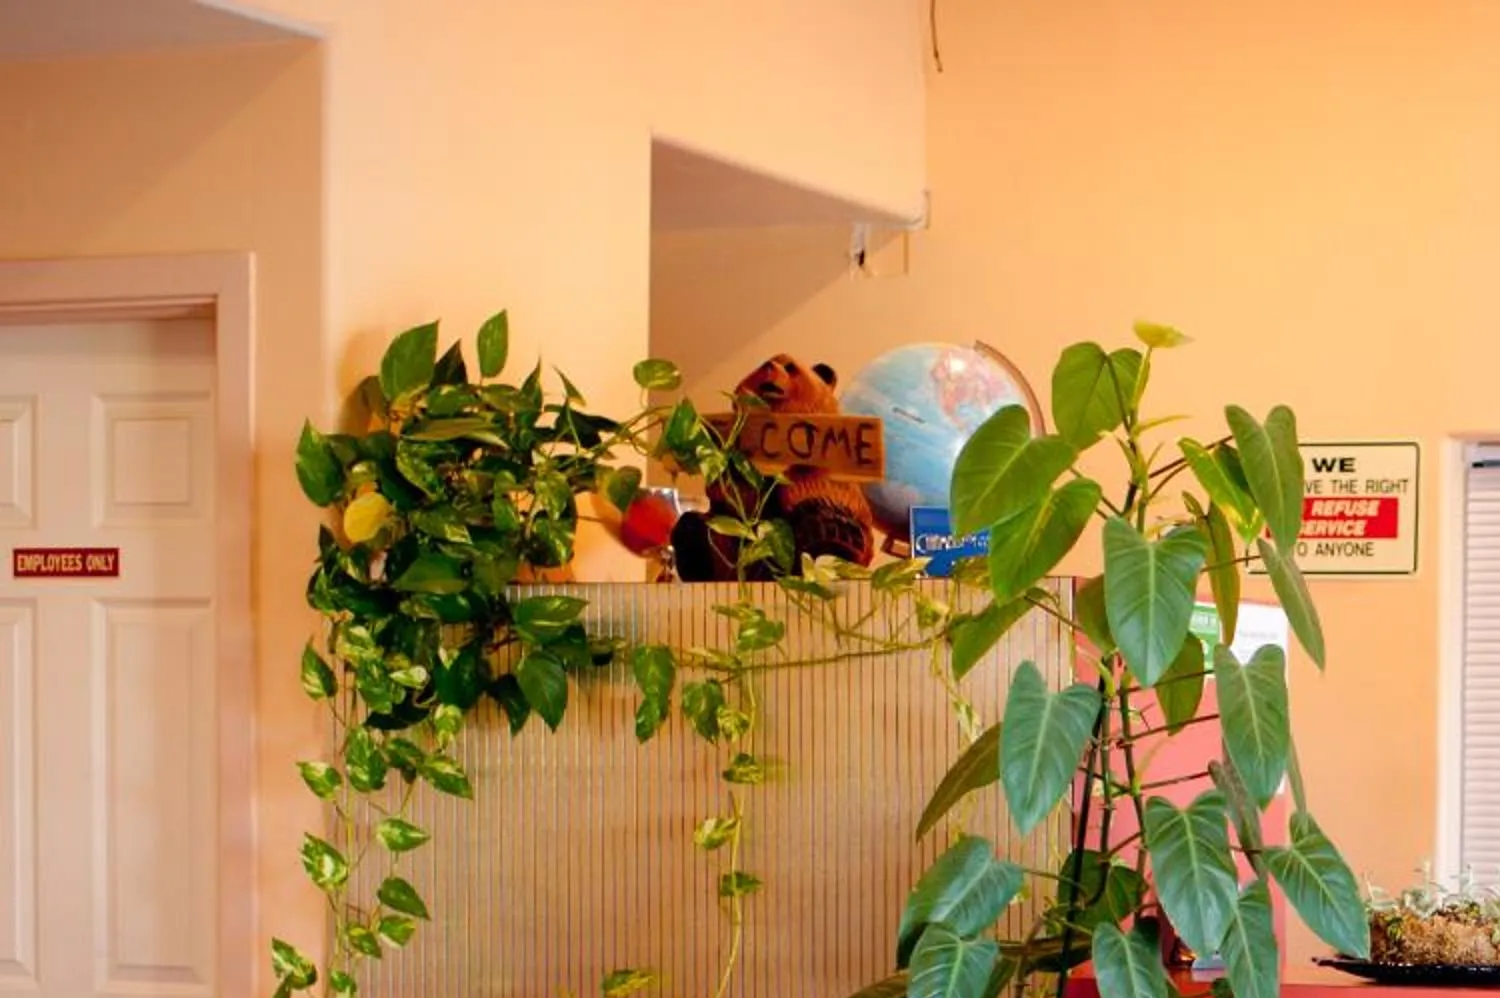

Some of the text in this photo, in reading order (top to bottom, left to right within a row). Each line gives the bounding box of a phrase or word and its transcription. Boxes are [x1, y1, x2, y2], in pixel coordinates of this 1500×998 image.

[737, 418, 878, 466] COME
[1312, 457, 1357, 473] WE
[1304, 479, 1408, 494] VE THE RIGHT
[1311, 499, 1381, 517] REFUSE
[1315, 541, 1375, 556] ANYONE
[17, 553, 115, 572] EMPLOYEES ONLY
